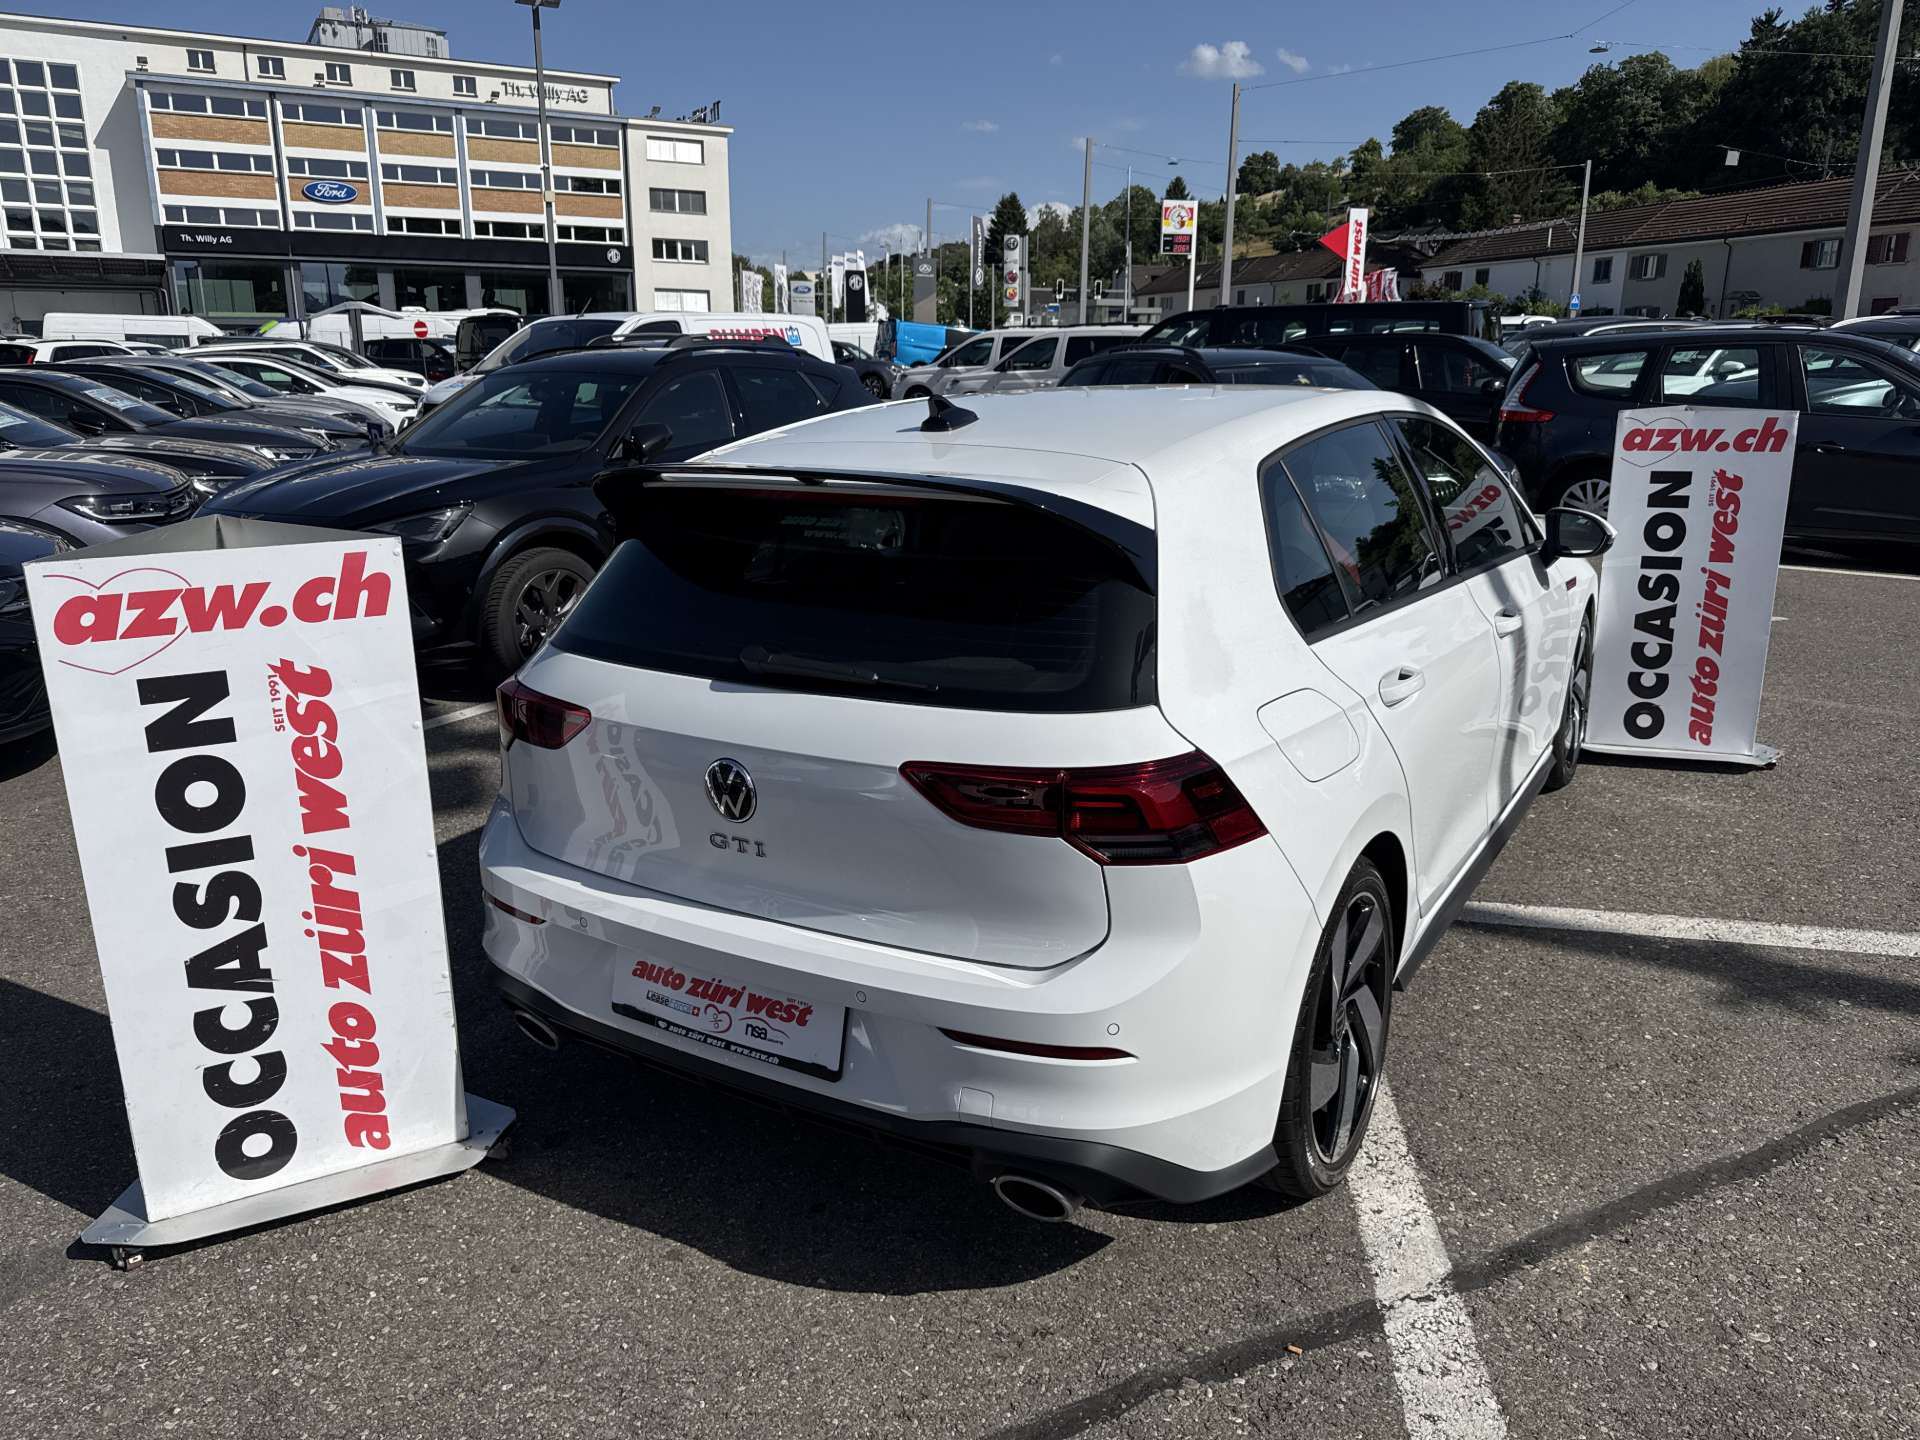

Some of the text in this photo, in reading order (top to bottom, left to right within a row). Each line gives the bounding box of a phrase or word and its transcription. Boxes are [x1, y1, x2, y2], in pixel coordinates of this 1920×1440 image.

[566, 88, 589, 104] AG
[312, 182, 351, 199] Ford
[180, 234, 233, 245] Th. Willy AG
[1353, 219, 1363, 255] west
[1623, 417, 1788, 453] azw.ch
[54, 551, 392, 646] azw.ch
[1623, 471, 1693, 740] OCCASION
[1688, 468, 1744, 747] auto züri west
[267, 674, 286, 732] SEIT 1991
[709, 832, 767, 859] GTI
[266, 658, 391, 1151] auto züri west
[136, 670, 298, 1180] OCCASION
[631, 960, 813, 1027] auto züri west
[668, 1025, 780, 1065] auto züri west www.azw.ch
[745, 1023, 768, 1040] nsa
